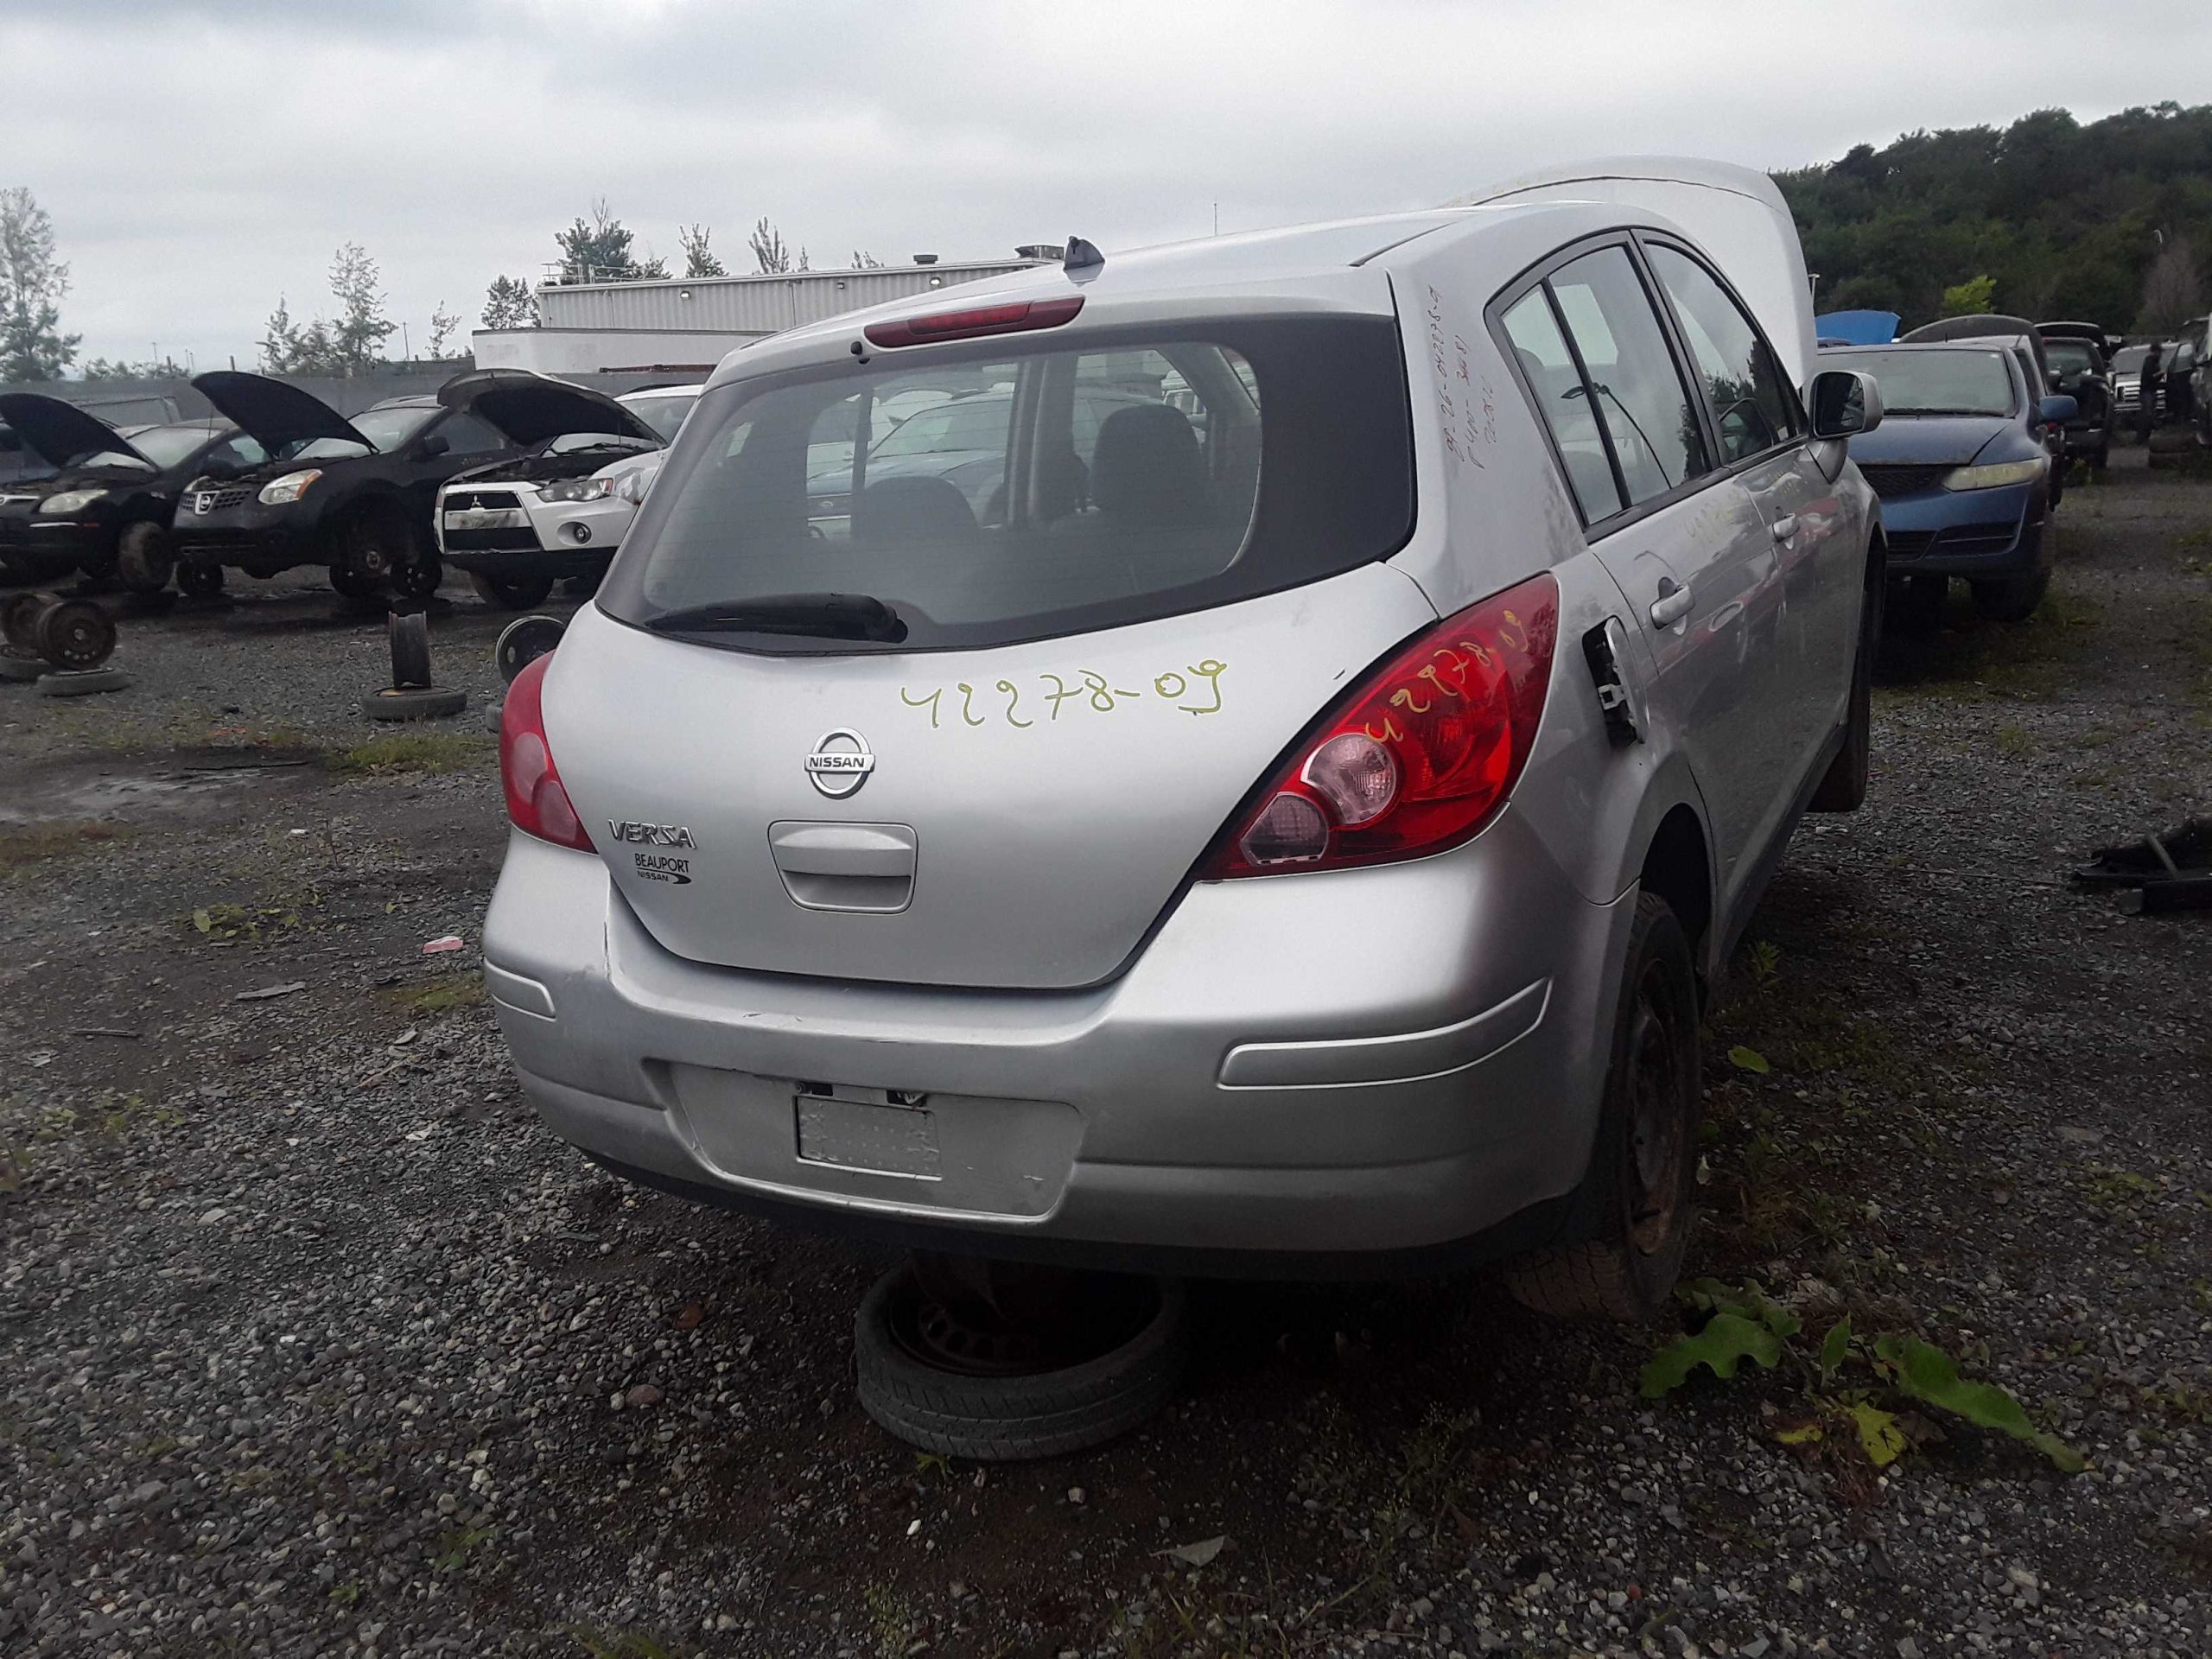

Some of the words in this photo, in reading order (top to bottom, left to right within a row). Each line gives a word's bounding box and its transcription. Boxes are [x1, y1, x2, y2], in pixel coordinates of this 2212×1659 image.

[809, 756, 865, 769] NISSAN
[607, 818, 698, 850] VERSA
[633, 852, 690, 873] BEAUPORT
[637, 871, 669, 882] NISSAN
